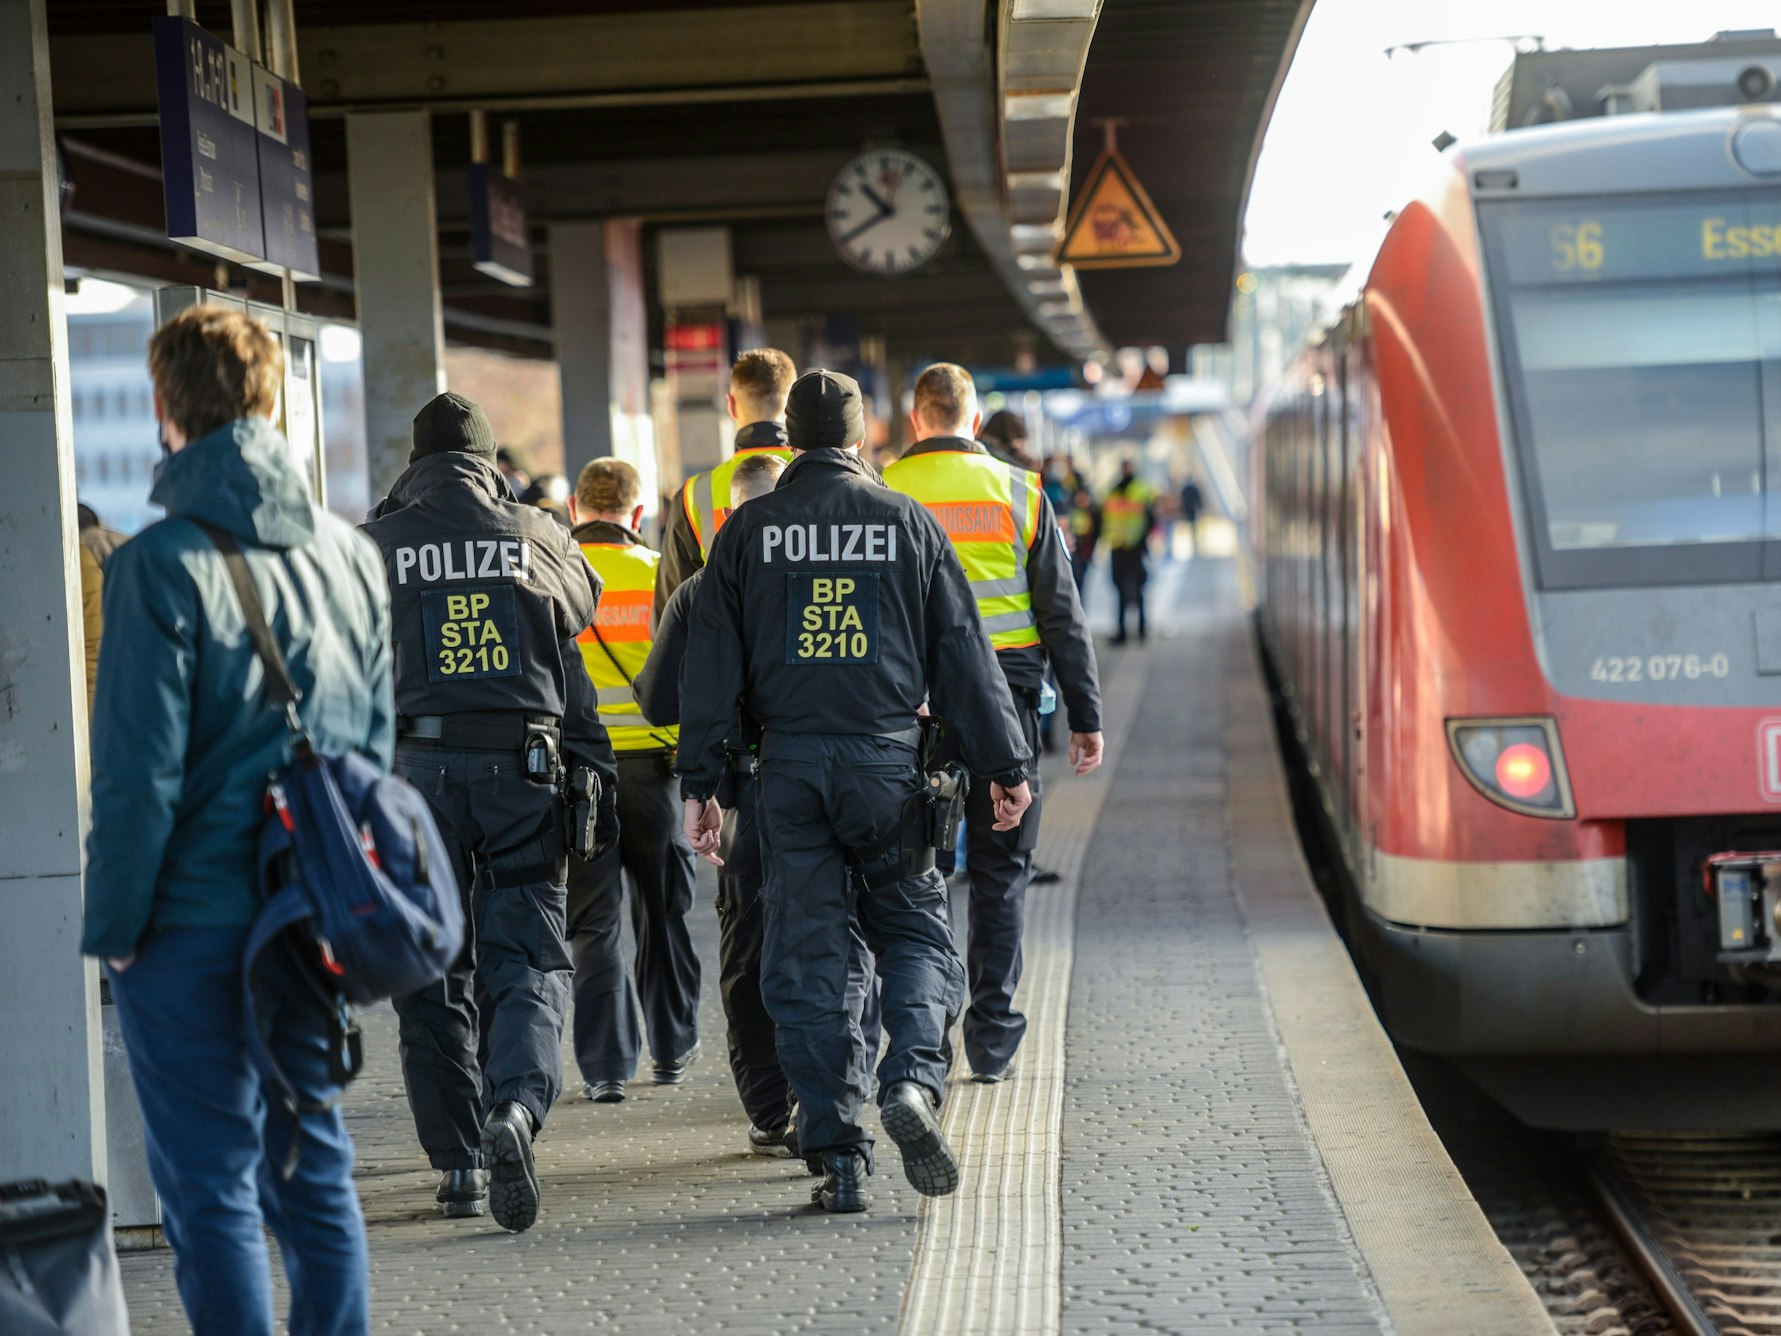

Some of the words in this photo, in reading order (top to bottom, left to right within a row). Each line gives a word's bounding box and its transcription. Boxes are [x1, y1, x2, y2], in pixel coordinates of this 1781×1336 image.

[1550, 222, 1604, 270] S6
[932, 505, 1002, 533] UNGSAMT
[762, 524, 897, 563] POLIZEI
[396, 541, 529, 584] POLIZEI
[812, 578, 855, 603] BP
[447, 593, 490, 620] BP
[802, 605, 863, 631] STA
[441, 619, 502, 648] STA
[798, 632, 868, 658] 3210
[439, 645, 509, 675] 3210
[1591, 656, 1643, 682] 422
[1647, 653, 1728, 680] 076-0
